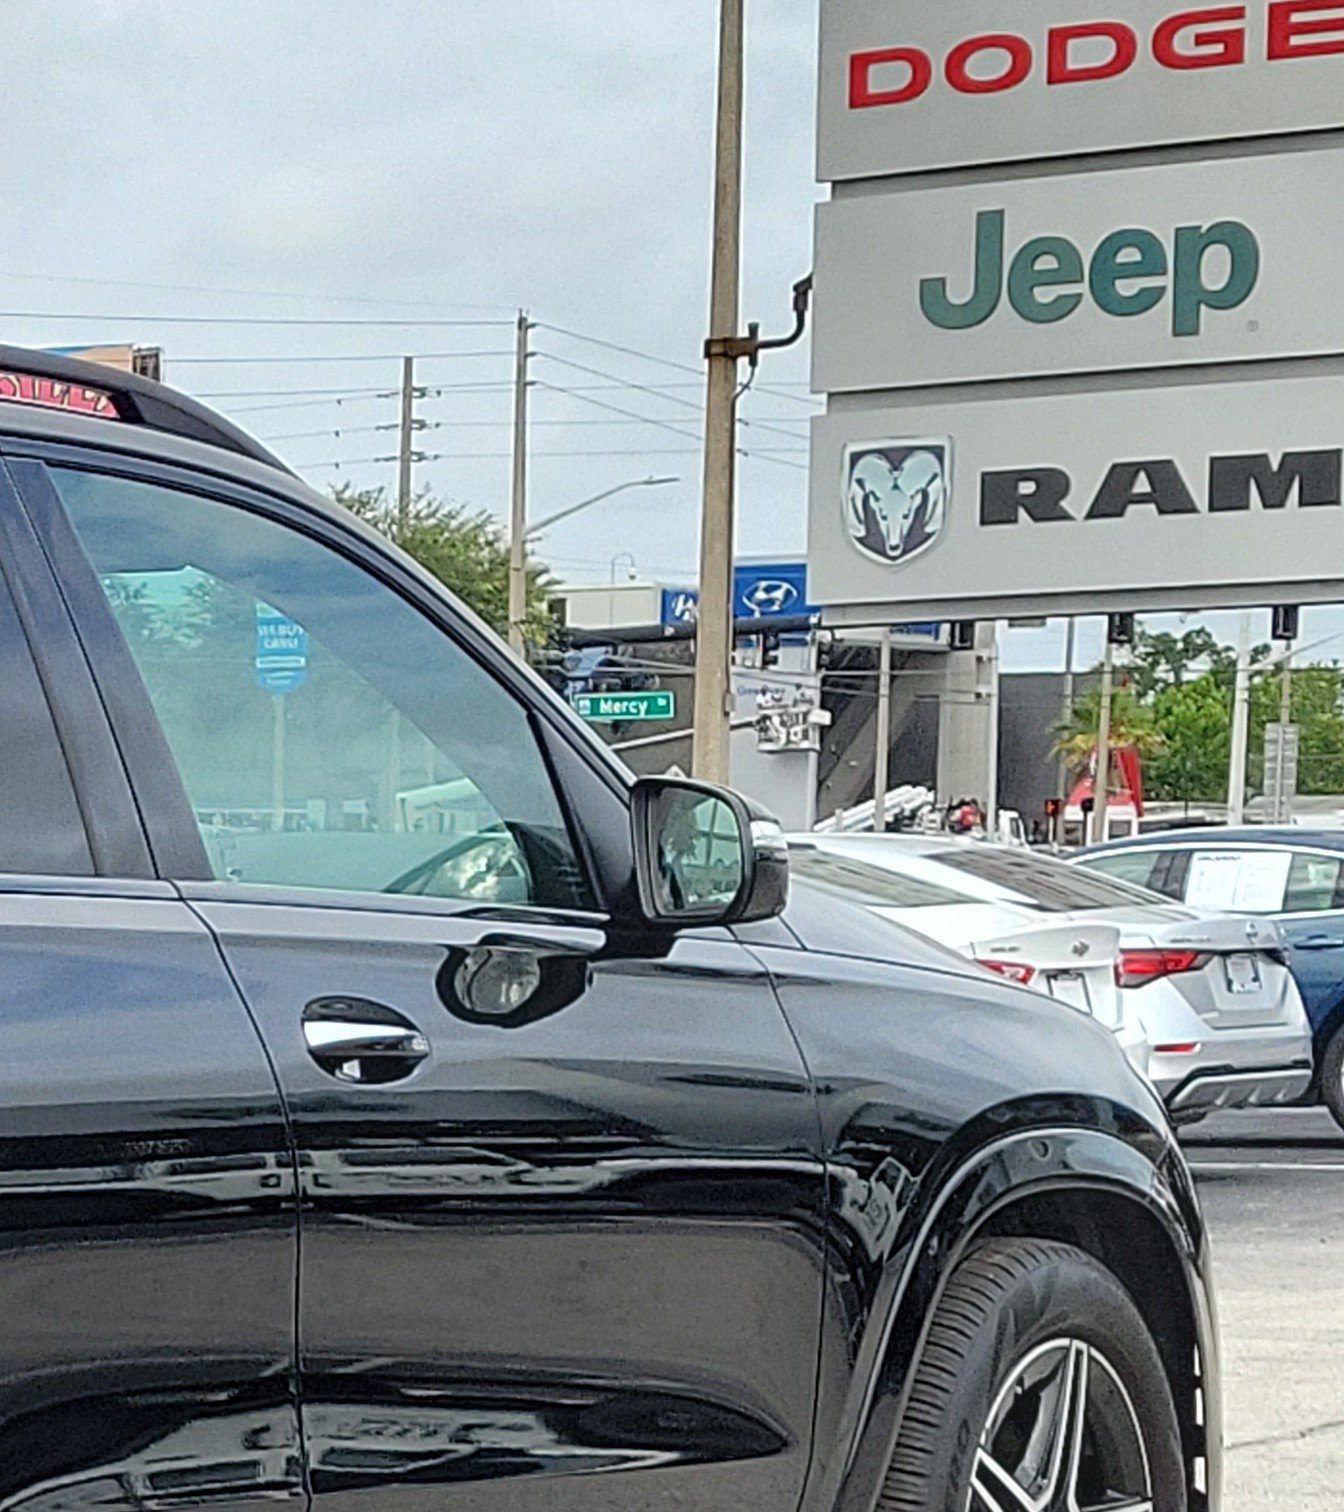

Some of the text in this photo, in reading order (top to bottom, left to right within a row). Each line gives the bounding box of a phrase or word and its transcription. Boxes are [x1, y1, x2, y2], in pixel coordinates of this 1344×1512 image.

[848, 0, 1344, 110] DODGE
[918, 208, 1260, 337] Jeep
[978, 448, 1342, 527] RAM
[599, 697, 649, 717] Mercy
